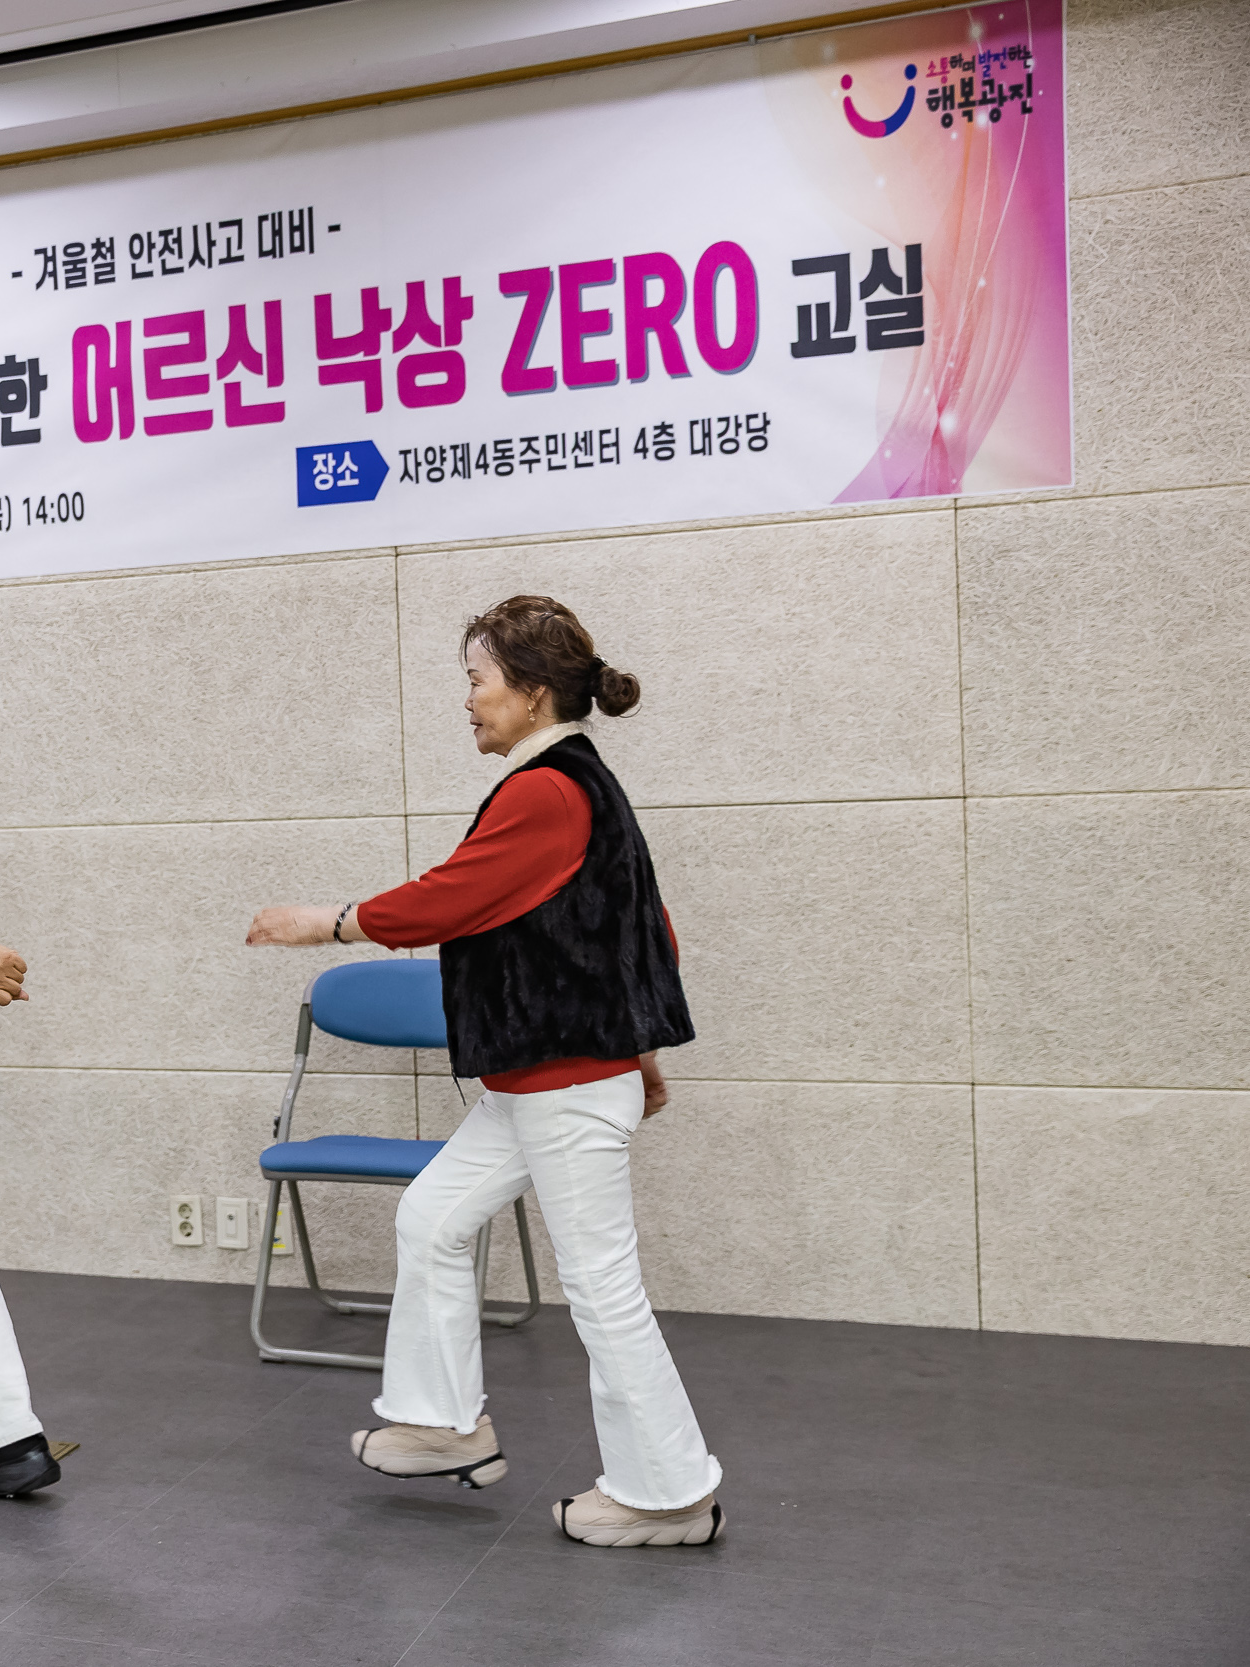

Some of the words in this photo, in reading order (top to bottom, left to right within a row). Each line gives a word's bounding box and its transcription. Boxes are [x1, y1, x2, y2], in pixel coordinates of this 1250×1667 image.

[925, 53, 976, 84] 소통하며
[978, 44, 1033, 78] 발전하는
[925, 73, 1034, 129] 행복광진
[34, 236, 116, 291] 겨울철
[129, 218, 245, 281] 안전사고
[257, 206, 315, 260] 대비
[72, 299, 287, 444] 어르신
[314, 275, 474, 415] 낙상
[498, 239, 760, 397] ZERO
[790, 243, 926, 359] 교실
[312, 451, 360, 492] 장소
[398, 427, 621, 484] 자양제4동주민센터
[633, 421, 676, 461] 4층
[689, 412, 771, 458] 대강당
[22, 491, 86, 527] 14:00
